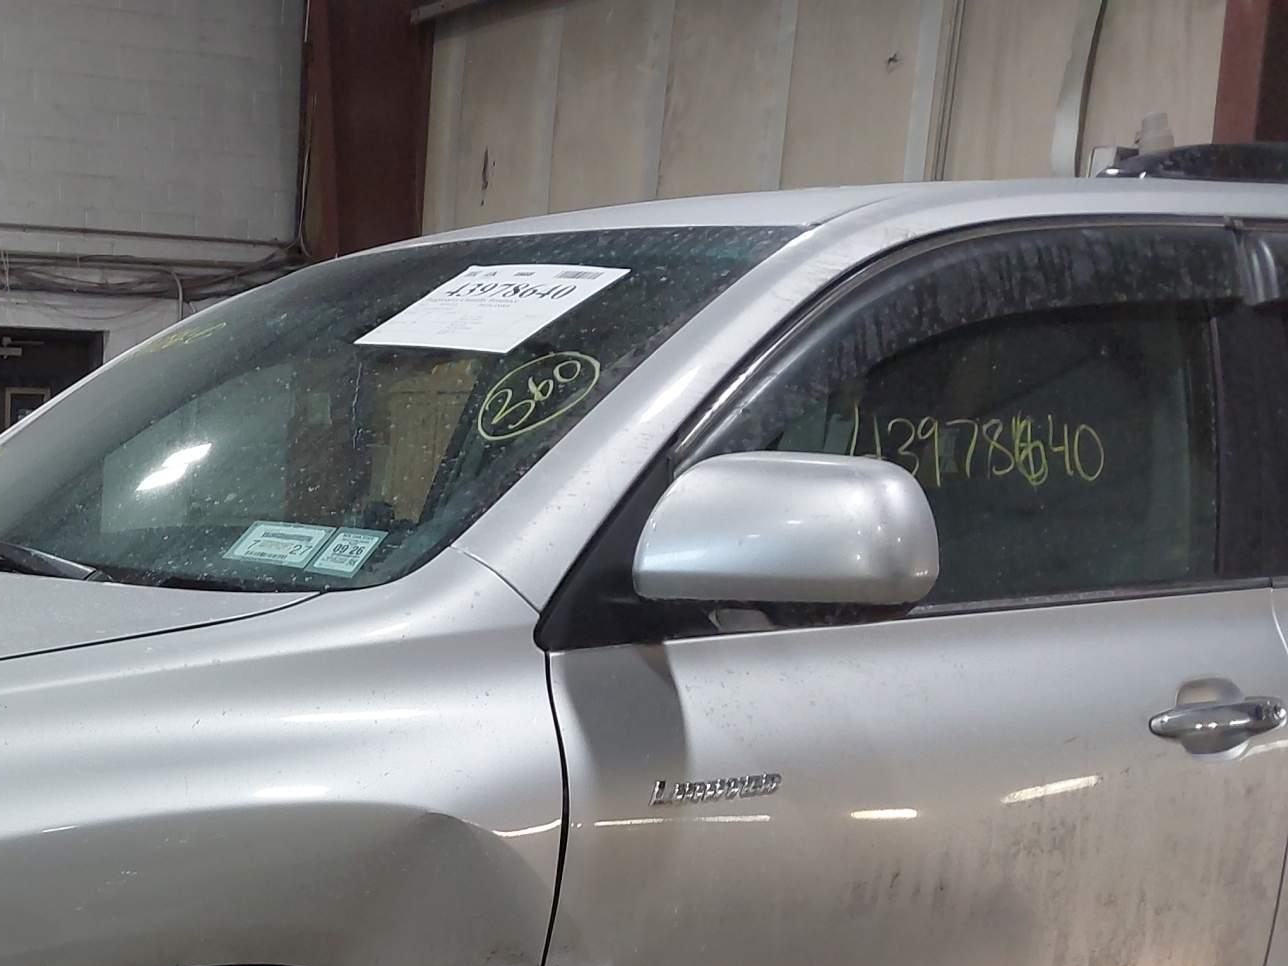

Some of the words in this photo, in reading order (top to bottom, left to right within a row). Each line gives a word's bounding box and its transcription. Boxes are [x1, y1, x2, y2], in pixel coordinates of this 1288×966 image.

[446, 282, 577, 300] 43978640
[485, 359, 581, 429] 360
[288, 544, 312, 556] 27
[332, 543, 350, 554] 09
[349, 545, 366, 556] 26
